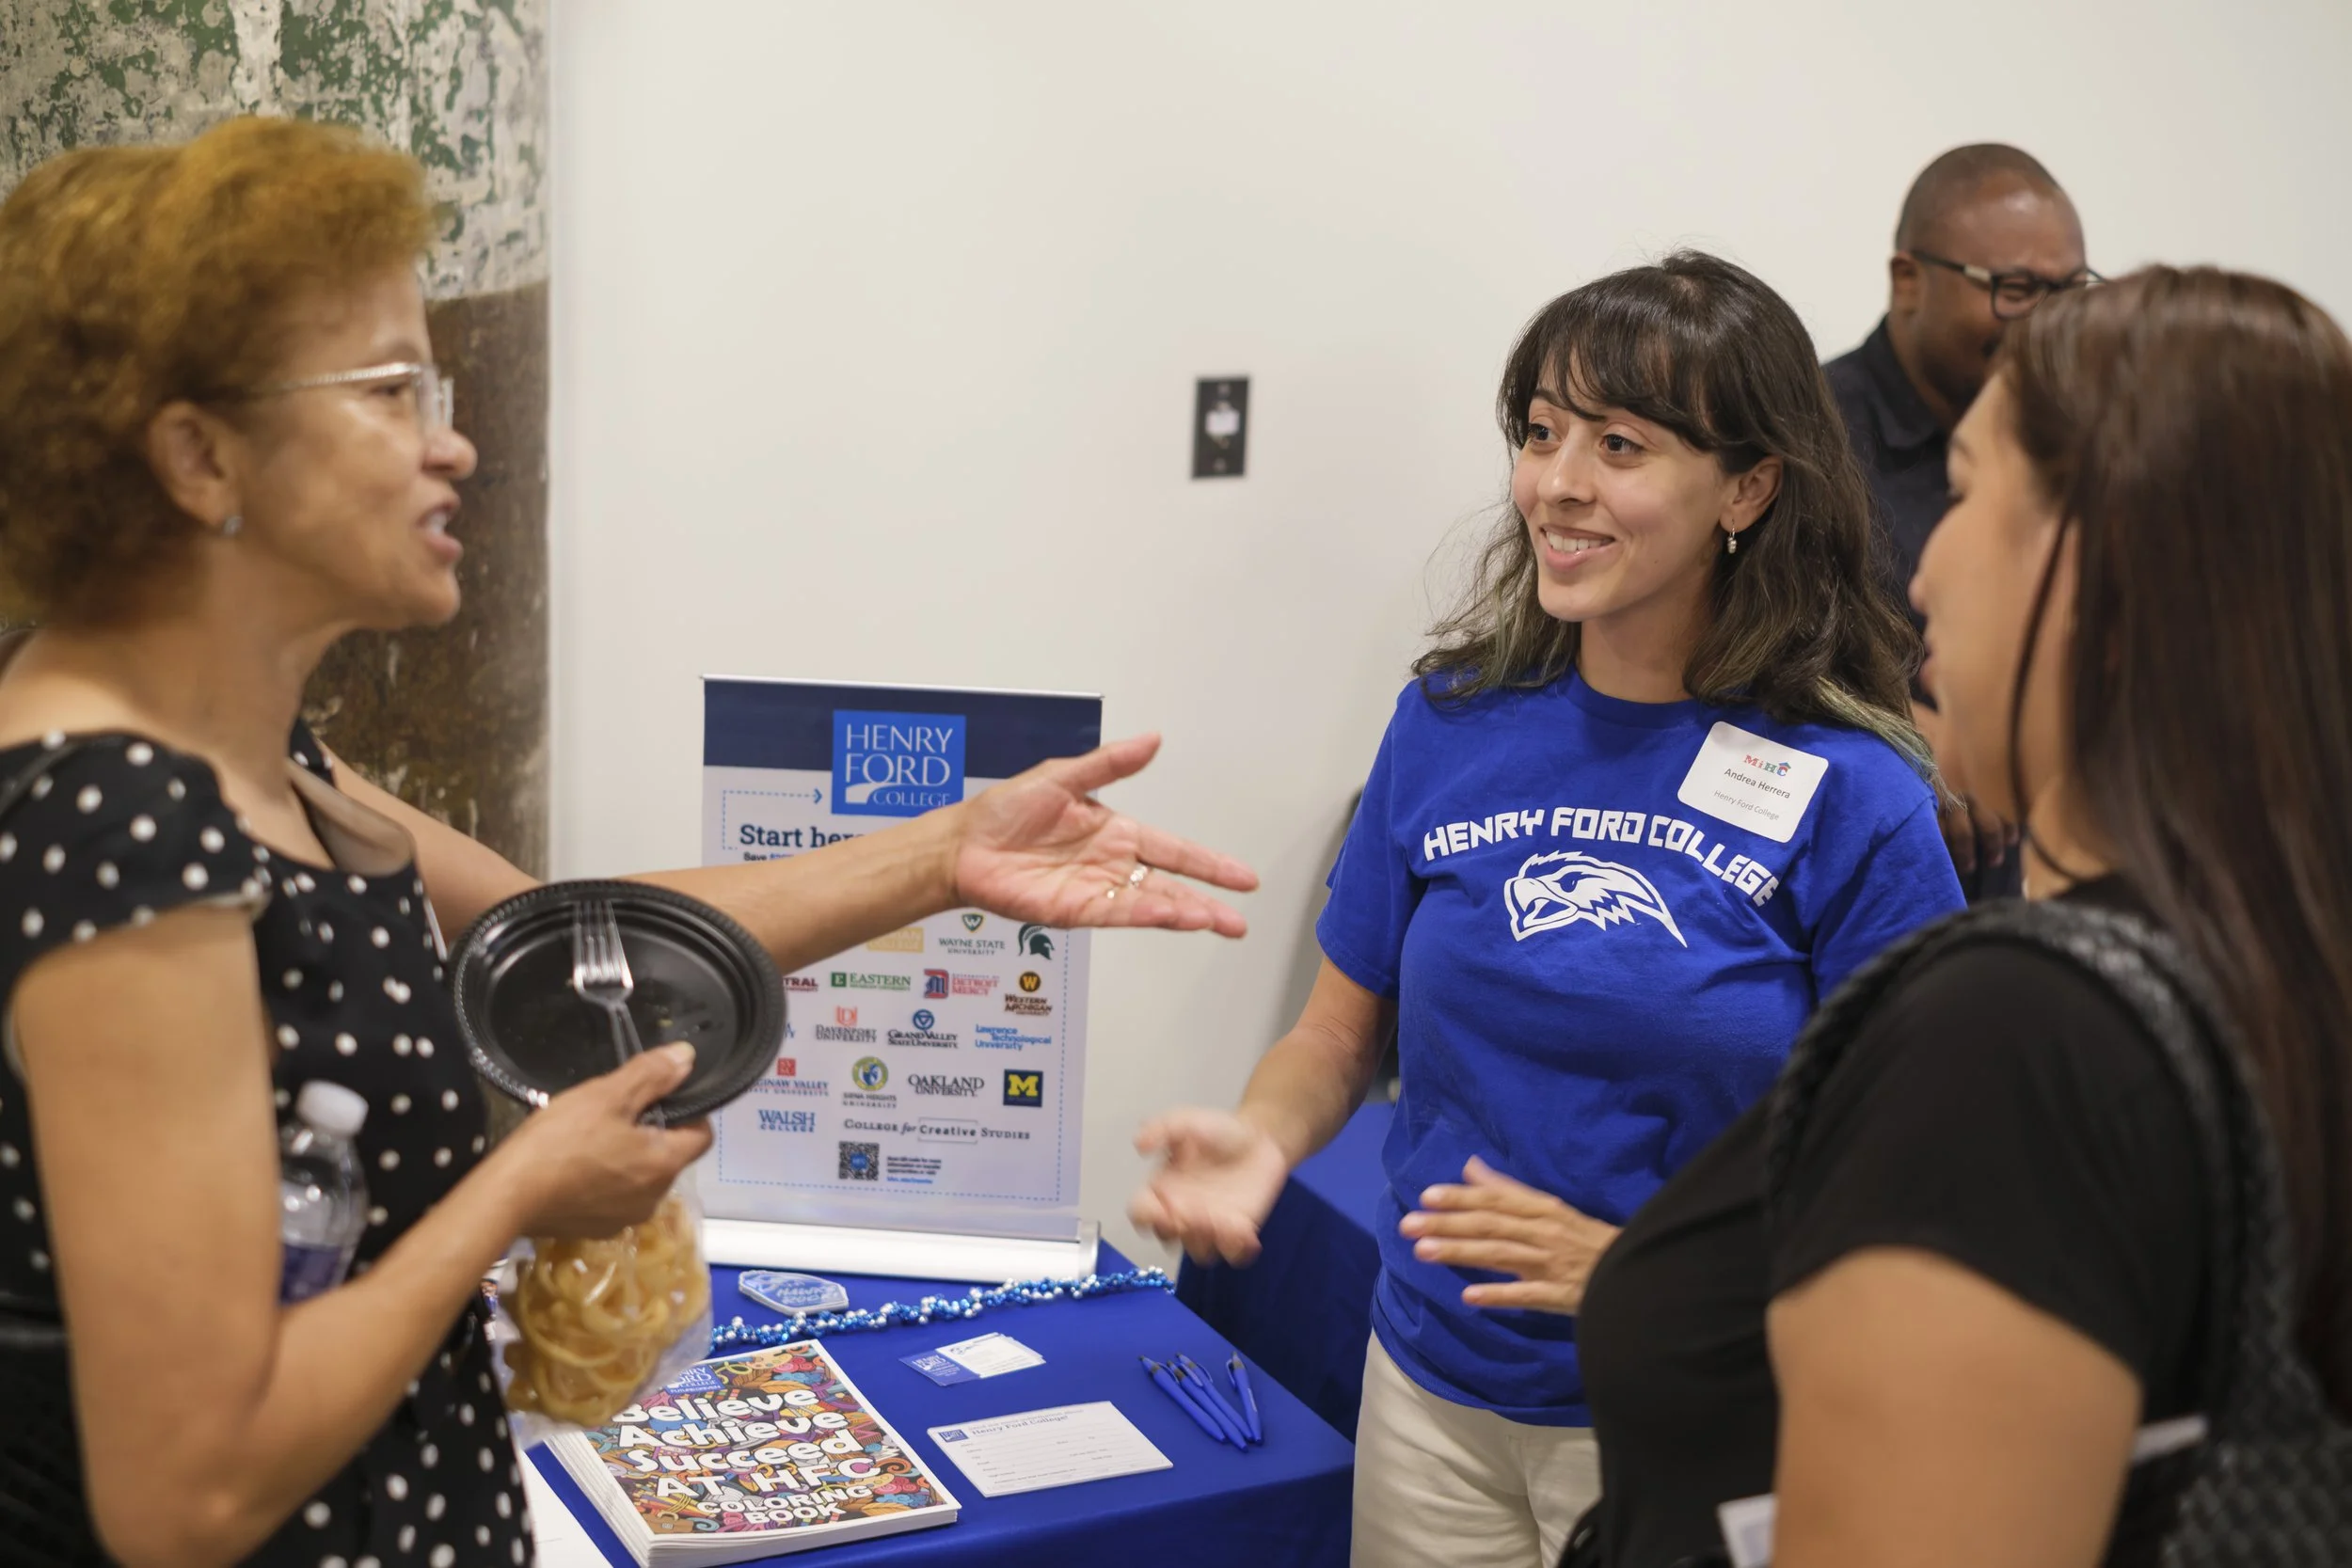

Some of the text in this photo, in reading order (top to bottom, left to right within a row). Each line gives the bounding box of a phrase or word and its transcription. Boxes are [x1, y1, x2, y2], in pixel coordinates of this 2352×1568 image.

[846, 723, 953, 753] HENRY
[845, 752, 950, 786] FORD
[1724, 768, 1790, 799] Andrea Herrera
[872, 790, 950, 807] COLLEGE
[1713, 790, 1780, 820] Henry Ford College
[740, 824, 803, 847] Start
[1423, 807, 1781, 909] HENRY FORD COLLEGE
[939, 938, 1005, 949] WAYNE STATE
[850, 974, 911, 986] EASTERN
[952, 977, 999, 988] DETROIT
[1023, 975, 1038, 990] W
[952, 987, 991, 995] MERCY
[1005, 993, 1047, 1004] WESTERN
[816, 1024, 877, 1036] DAVENPORT
[888, 1029, 958, 1041] GRAND VALLEY
[976, 1024, 1018, 1035] Lawrence
[816, 1034, 877, 1043] UNIVERSITY
[976, 1040, 1023, 1051] University
[992, 1034, 1052, 1044] Technological
[794, 1080, 829, 1089] VALLEY
[908, 1074, 985, 1089] OAKLAND
[1008, 1074, 1039, 1096] M
[758, 1109, 816, 1126] WALSH
[760, 1124, 815, 1132] COLLEGE
[844, 1118, 1030, 1139] COLLEGE for Creative STUDIES
[612, 1388, 818, 1423] Believe
[619, 1411, 849, 1449] Achieve
[972, 1424, 1004, 1436] Henry
[1006, 1420, 1028, 1431] Ford
[628, 1430, 863, 1473] Succeed
[656, 1457, 882, 1497] AT HFC
[696, 1484, 873, 1513] COLORING
[741, 1502, 846, 1524] BOOK
